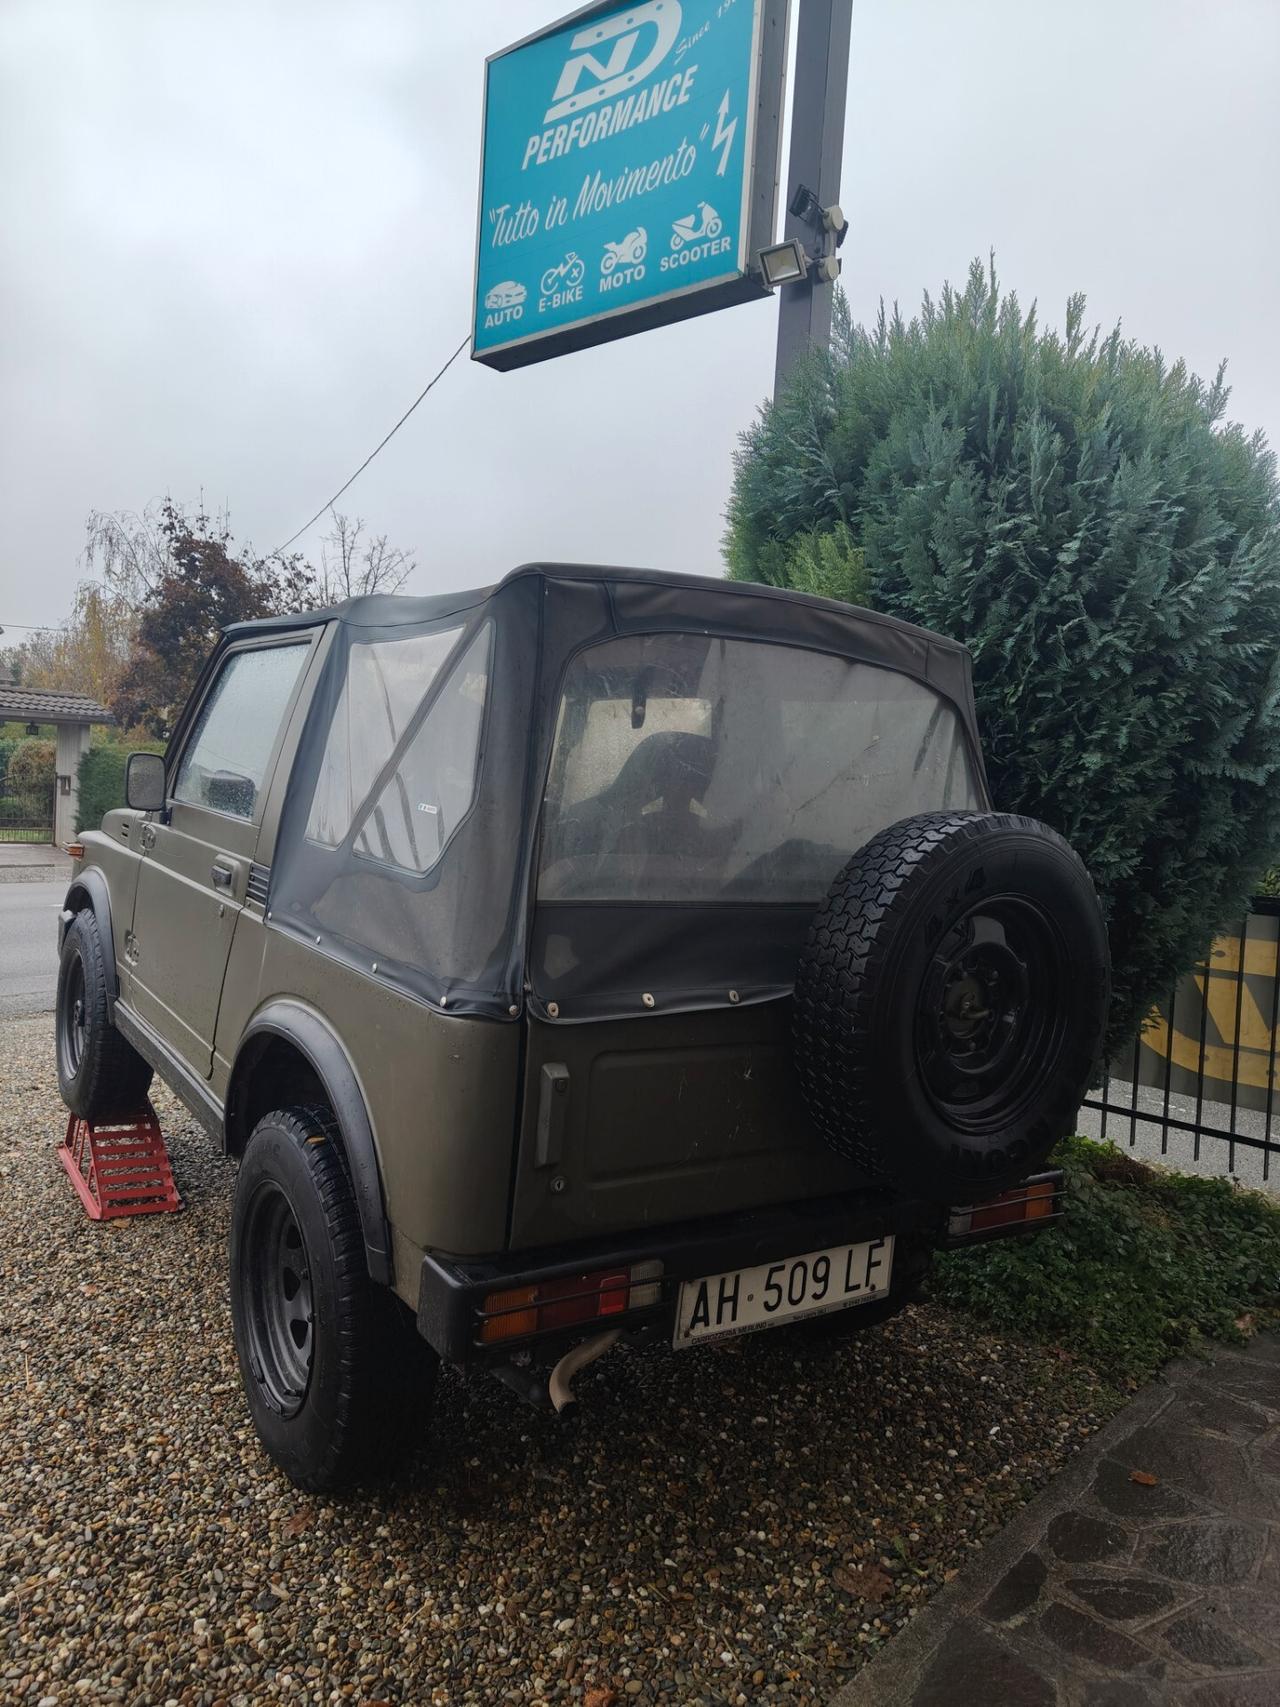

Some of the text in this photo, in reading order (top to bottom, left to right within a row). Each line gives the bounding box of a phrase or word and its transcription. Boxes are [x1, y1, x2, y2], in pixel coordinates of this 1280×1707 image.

[673, 20, 710, 66] Since
[521, 64, 699, 171] PERFORMANCE
[545, 195, 568, 230] in
[660, 236, 731, 272] SCOOTER
[599, 265, 646, 293] MOTO
[484, 305, 524, 329] AUTO
[538, 287, 584, 313] E-BIKE
[690, 1242, 885, 1330] AH 509 LF
